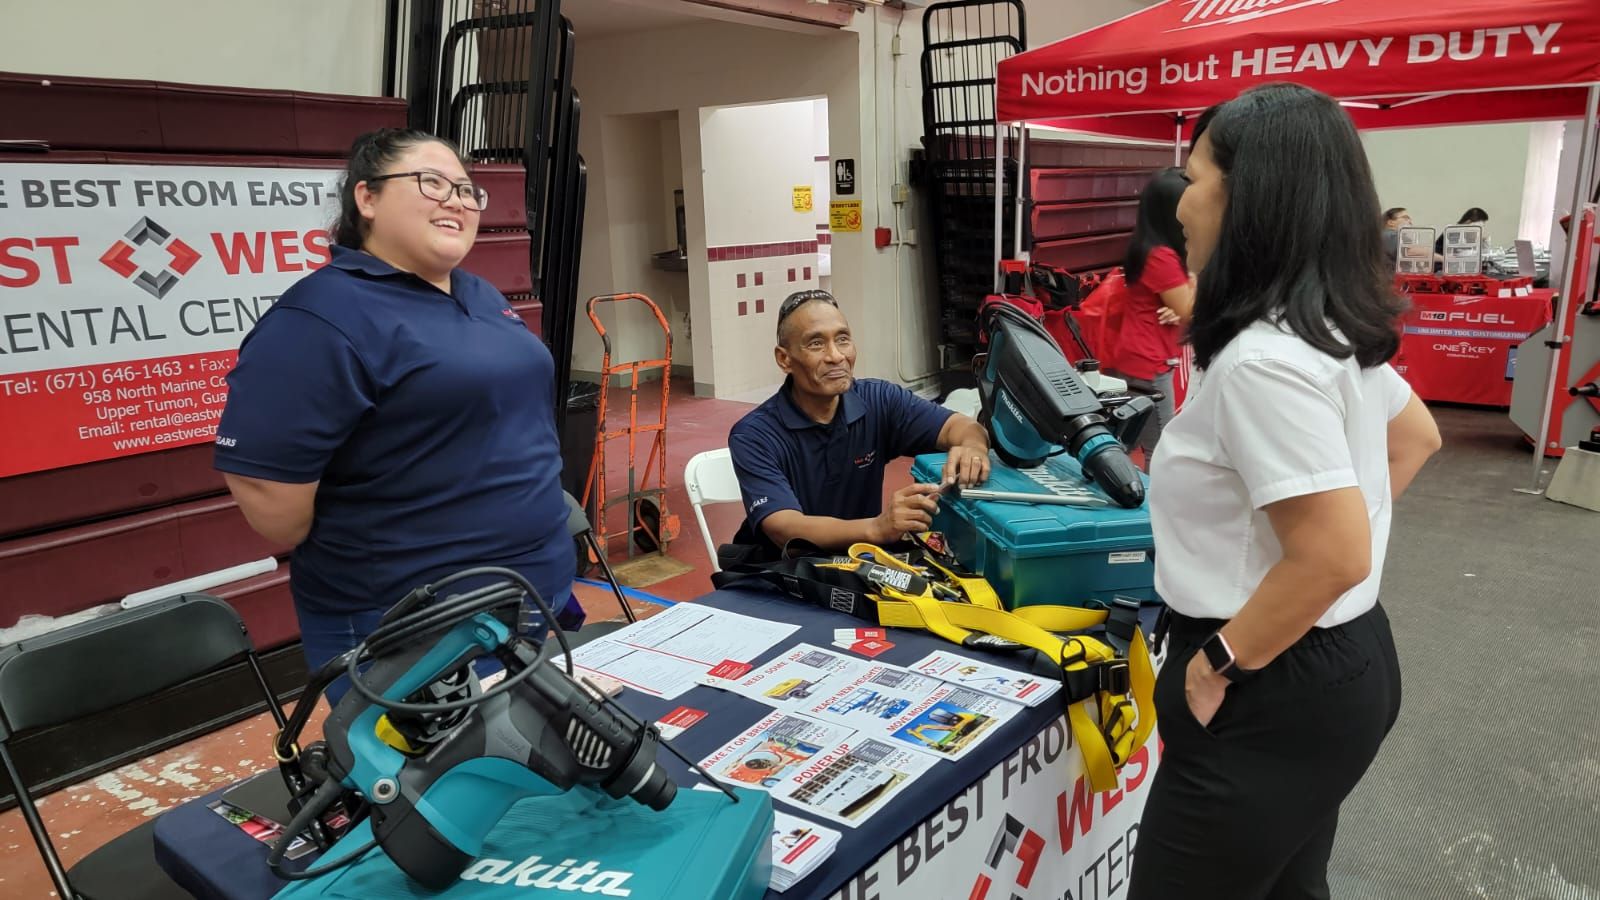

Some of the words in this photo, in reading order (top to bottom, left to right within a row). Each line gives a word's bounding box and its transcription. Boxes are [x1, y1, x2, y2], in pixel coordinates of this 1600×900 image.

[1021, 65, 1148, 97] Nothing
[1159, 53, 1220, 87] but
[1231, 37, 1394, 79] HEAVY
[1406, 22, 1562, 64] DUTY.
[21, 179, 121, 208] BEST
[134, 180, 238, 207] FROM
[247, 181, 343, 206] EAST-
[0, 304, 166, 355] ENTAL
[1421, 312, 1446, 321] M18
[1449, 312, 1515, 325] FUEL
[1433, 343, 1459, 353] ONE
[1468, 345, 1496, 354] KEY
[1, 378, 38, 397] Tel:
[45, 371, 97, 395] (671)
[102, 361, 182, 384] 646-1463
[200, 358, 230, 372] Fax:
[83, 390, 112, 405] 958
[116, 383, 157, 400] North
[161, 377, 206, 394] Marine
[78, 422, 125, 440] Email:
[130, 408, 224, 432] rental@eastw
[96, 405, 141, 421] Upper
[146, 396, 199, 414] Tumon,
[743, 674, 765, 688] NEED
[764, 661, 788, 676] SOME
[811, 695, 837, 713] REACH
[837, 683, 854, 698] NEW
[853, 665, 882, 687] HEIGHTS
[886, 716, 910, 732] MOVE
[909, 688, 949, 719] MOUNTAINS
[702, 751, 726, 769] MAKE
[724, 744, 735, 755] IT
[734, 735, 748, 748] OR
[748, 718, 774, 738] BREAK
[771, 712, 783, 724] IT
[792, 752, 836, 784] POWER
[832, 743, 852, 759] UP
[896, 772, 991, 886] BEST
